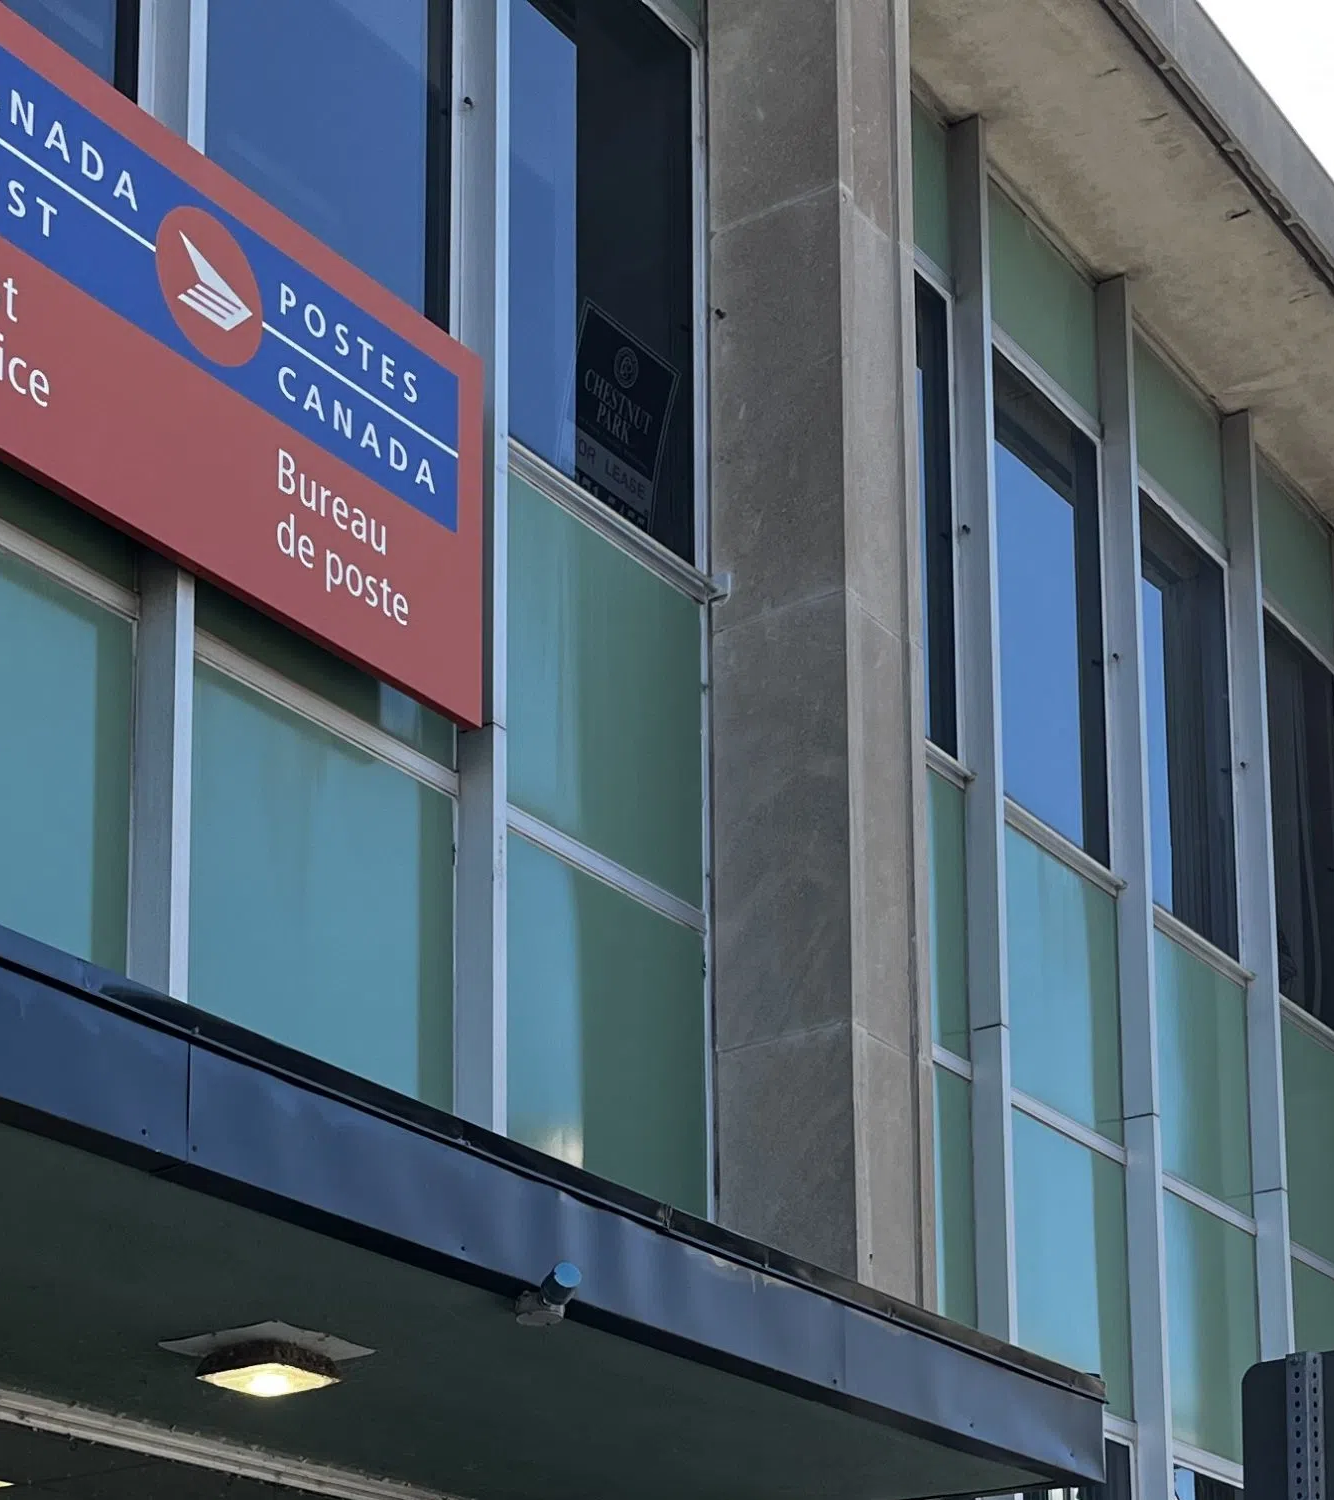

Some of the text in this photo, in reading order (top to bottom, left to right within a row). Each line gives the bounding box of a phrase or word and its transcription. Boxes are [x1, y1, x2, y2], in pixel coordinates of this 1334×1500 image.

[280, 284, 418, 402] POSTES
[278, 367, 435, 494] CANADA
[584, 368, 653, 436] CHESTNUT
[597, 404, 632, 445] PARK
[278, 449, 386, 555] Bureau
[605, 458, 646, 500] LEASE
[277, 516, 409, 626] de poste
